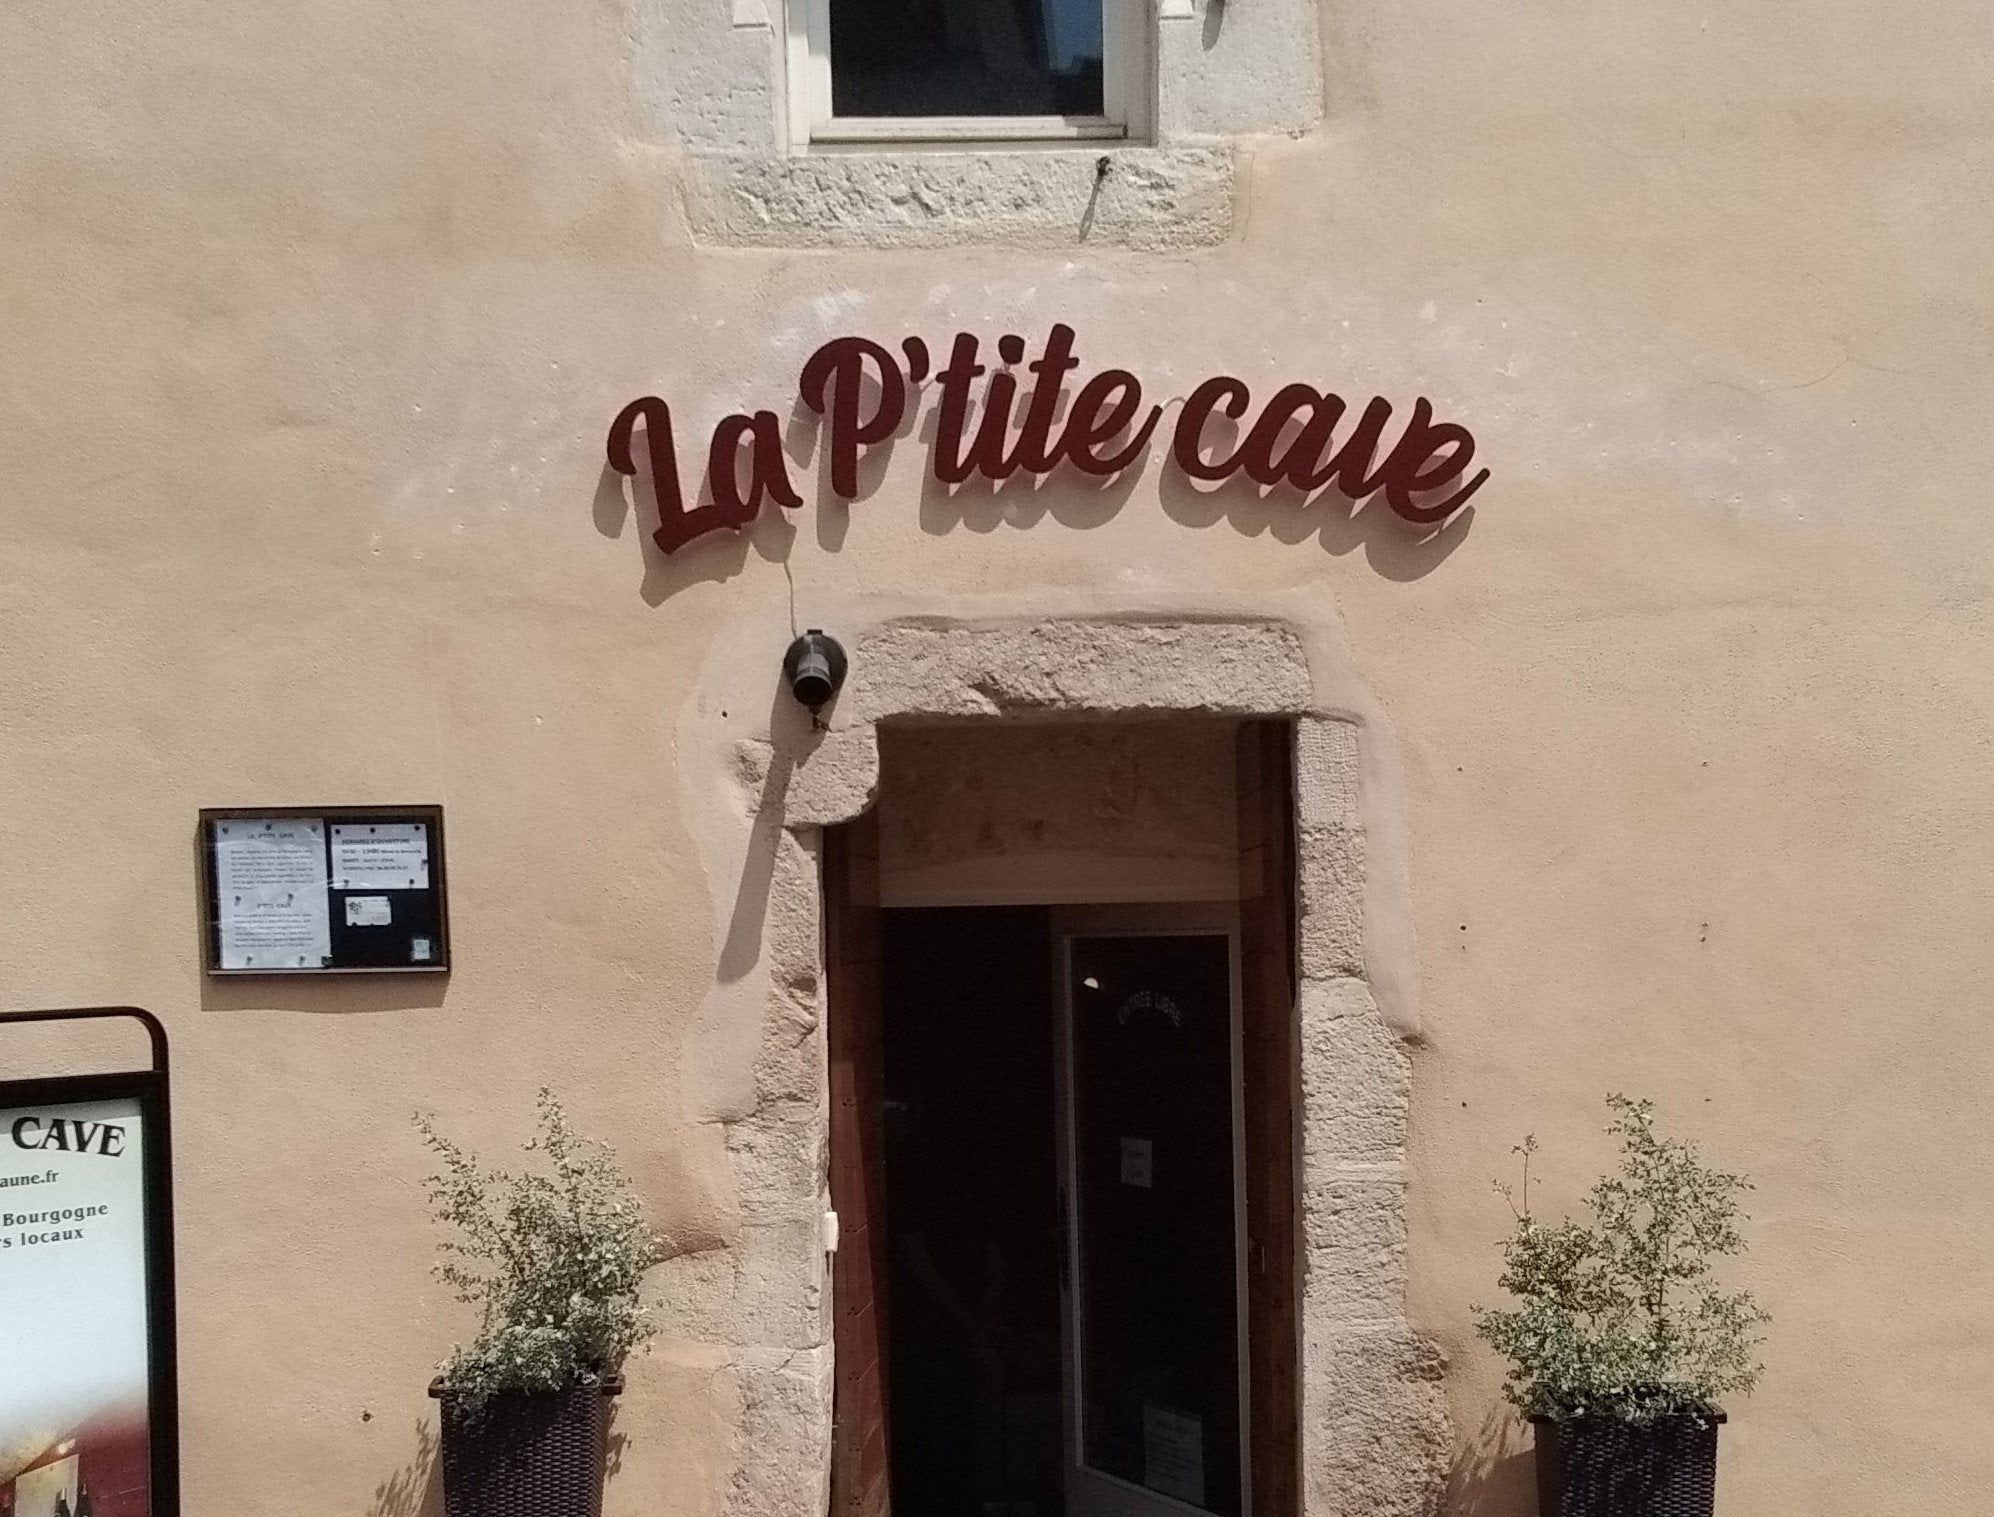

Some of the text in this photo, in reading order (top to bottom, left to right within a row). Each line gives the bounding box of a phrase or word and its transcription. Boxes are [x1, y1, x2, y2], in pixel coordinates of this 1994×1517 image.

[606, 323, 1491, 555] La P'tite cave
[11, 1116, 126, 1157] CAVE
[0, 1169, 60, 1188] aune.fr
[2, 1204, 109, 1227] Bourgogne
[20, 1228, 84, 1246] locaux
